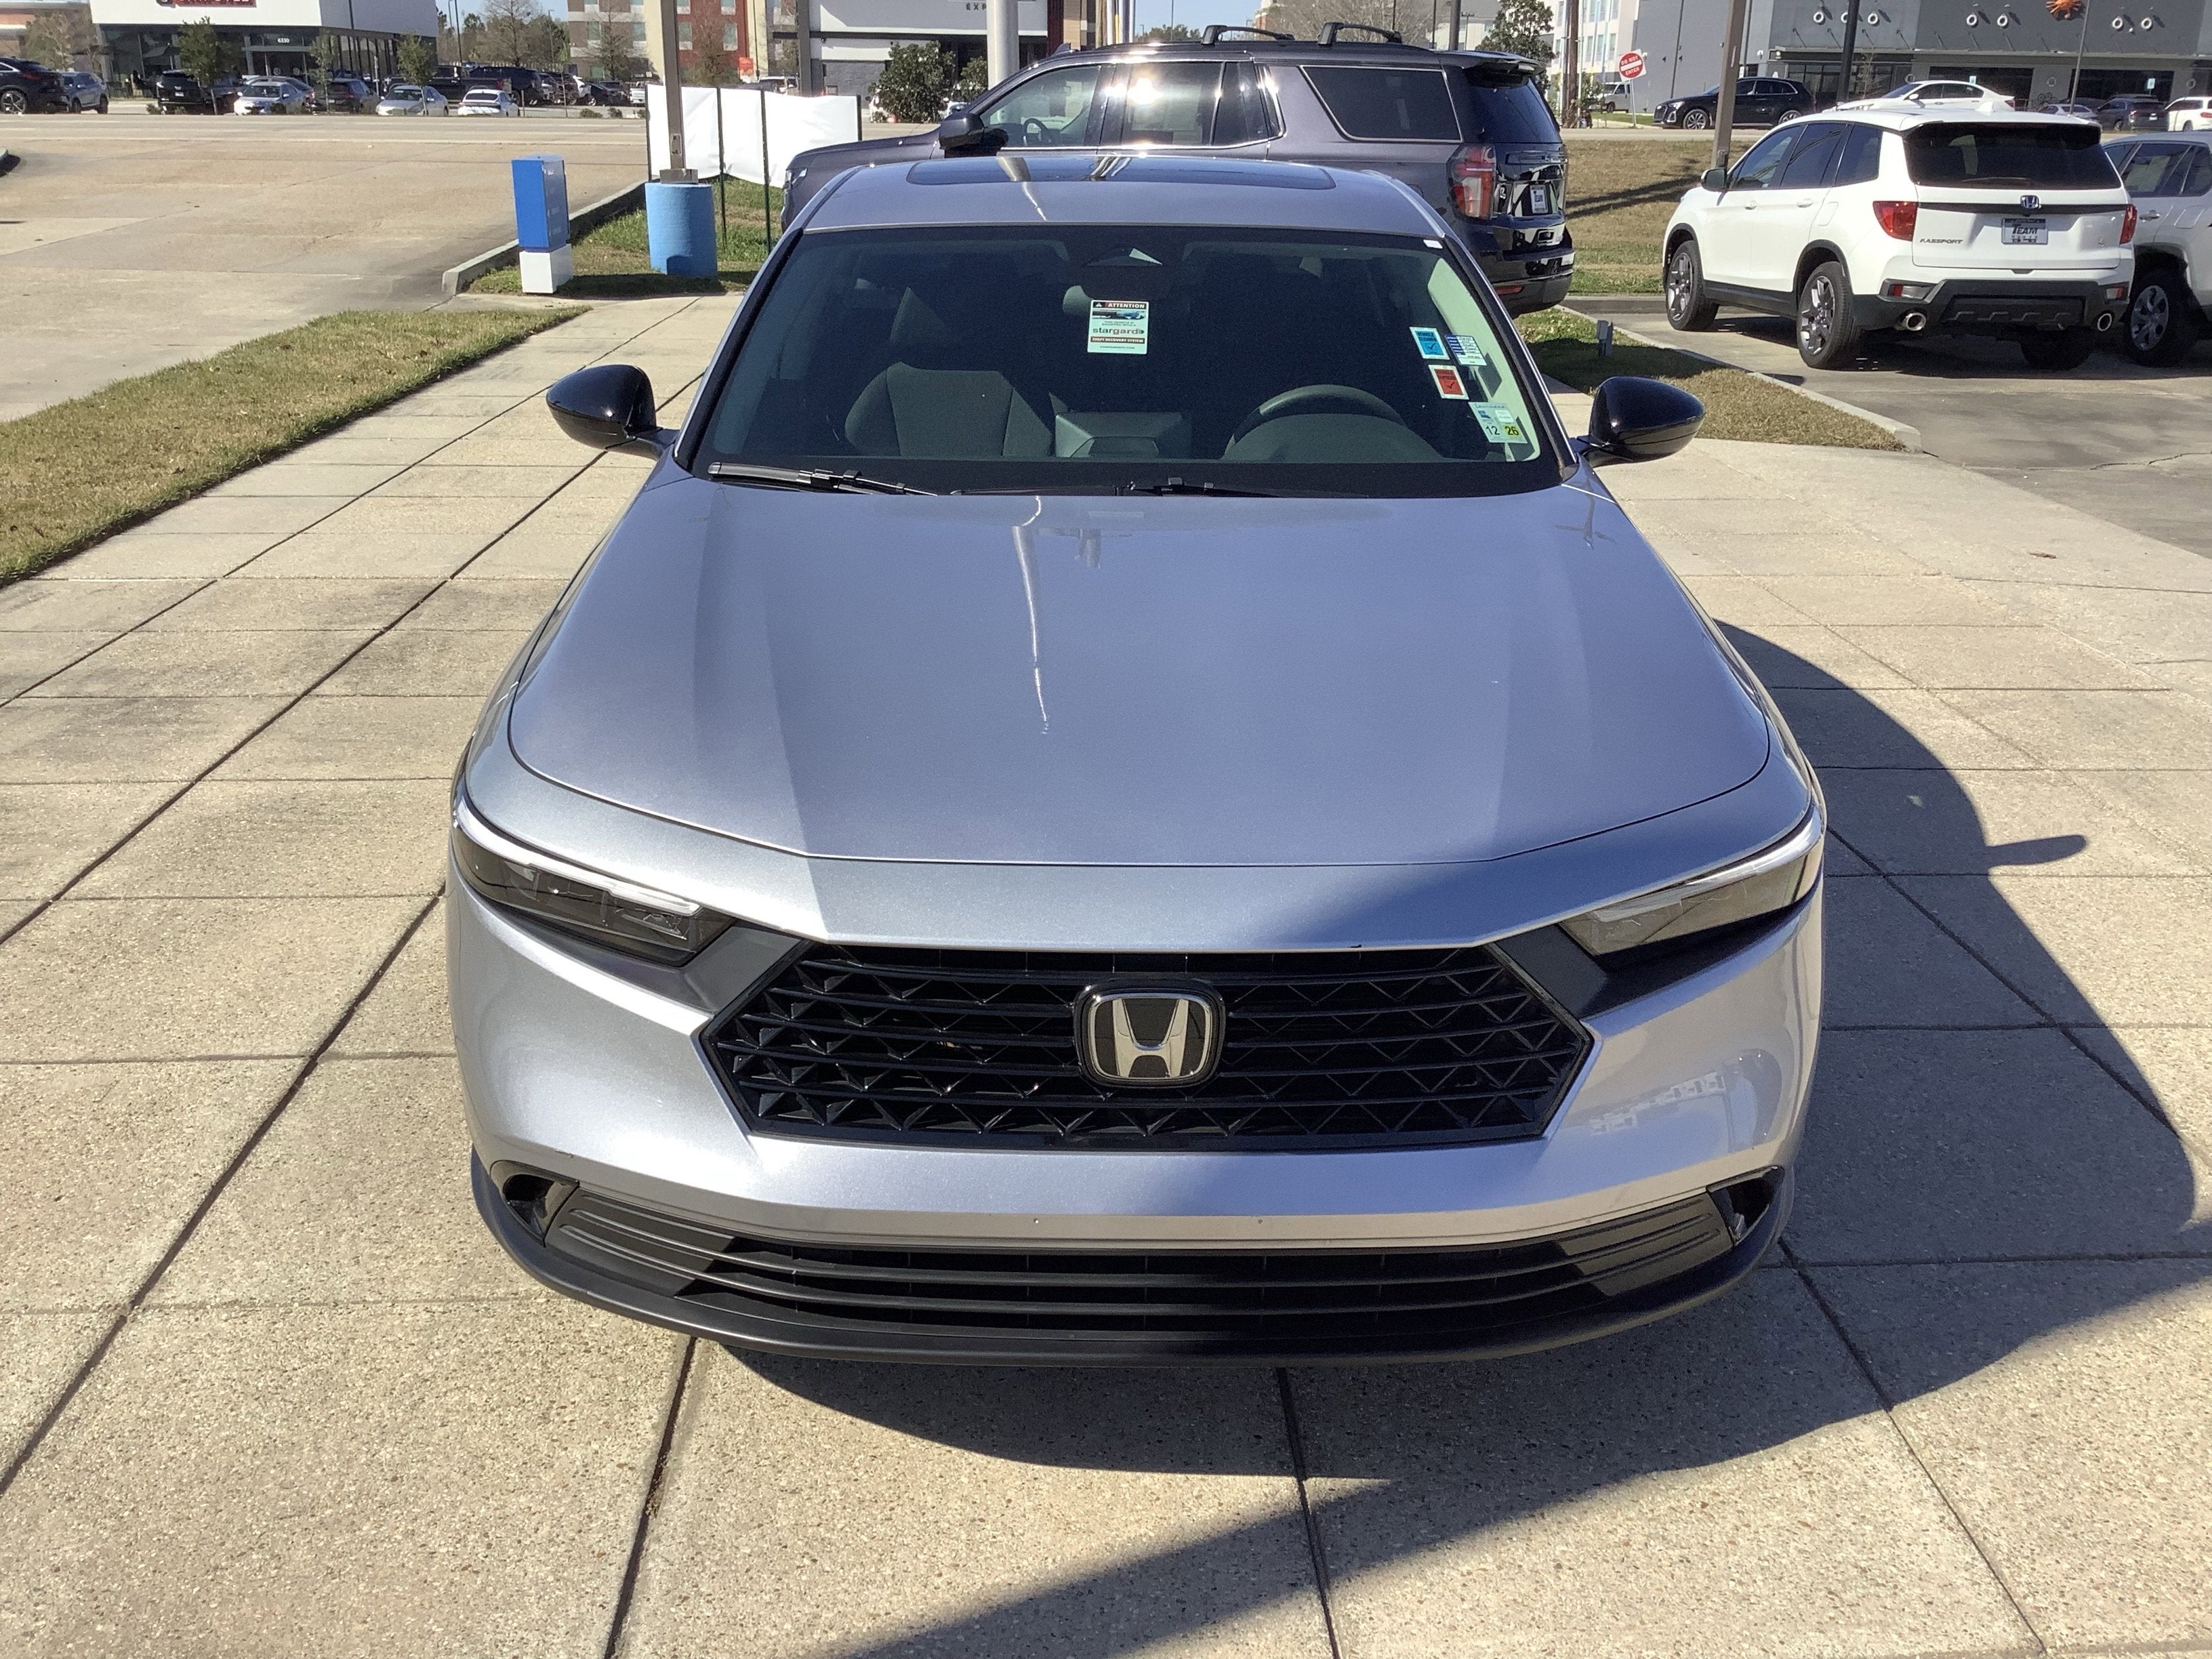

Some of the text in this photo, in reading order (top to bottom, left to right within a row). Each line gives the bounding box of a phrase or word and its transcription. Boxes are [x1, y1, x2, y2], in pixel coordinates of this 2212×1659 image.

[1625, 66, 1640, 75] ENTER
[2012, 224, 2038, 234] TEAM
[1486, 426, 1519, 436] 12 26
